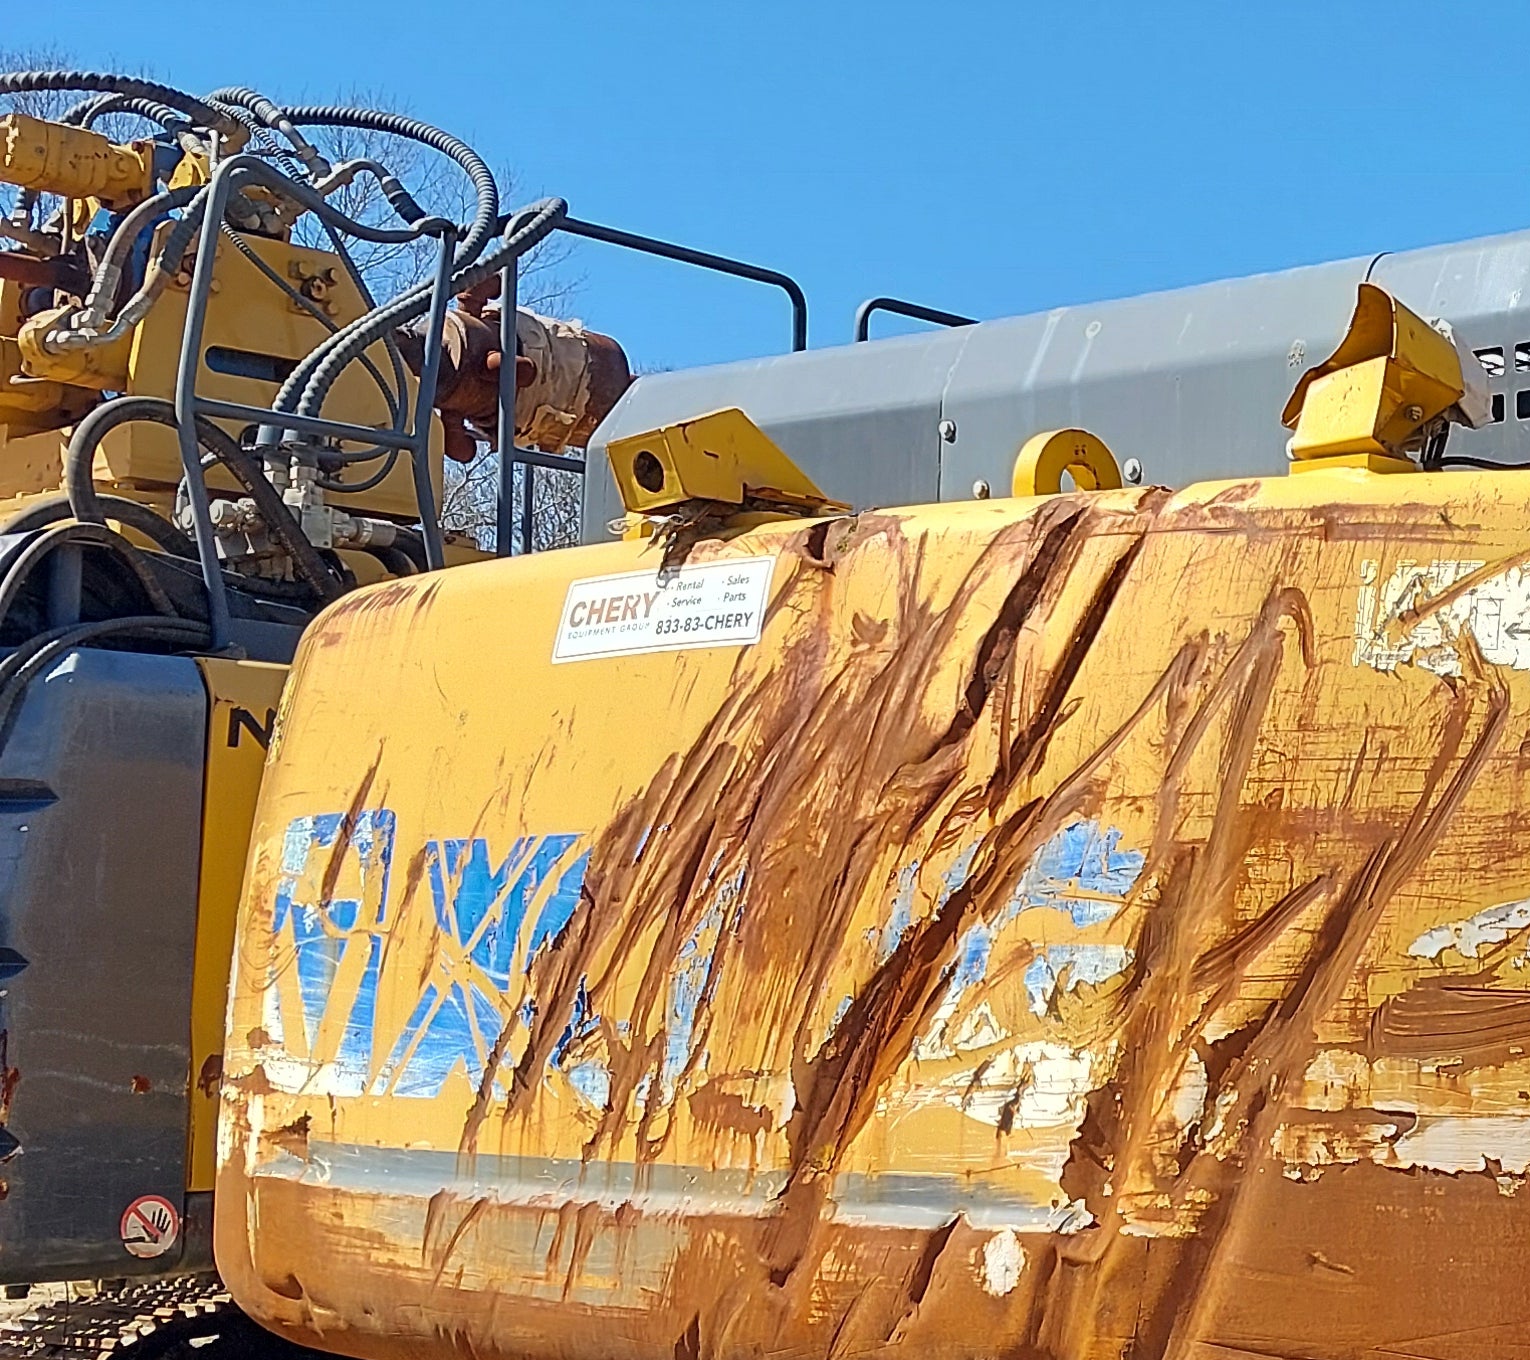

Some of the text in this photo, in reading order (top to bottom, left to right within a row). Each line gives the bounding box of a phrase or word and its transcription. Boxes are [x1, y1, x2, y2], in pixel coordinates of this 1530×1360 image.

[676, 574, 750, 591] Rental Sales
[671, 592, 746, 608] Service Parts
[569, 591, 661, 628] CHERY
[655, 611, 753, 635] 833-83-CHERY
[567, 625, 617, 640] EQUIPMENT
